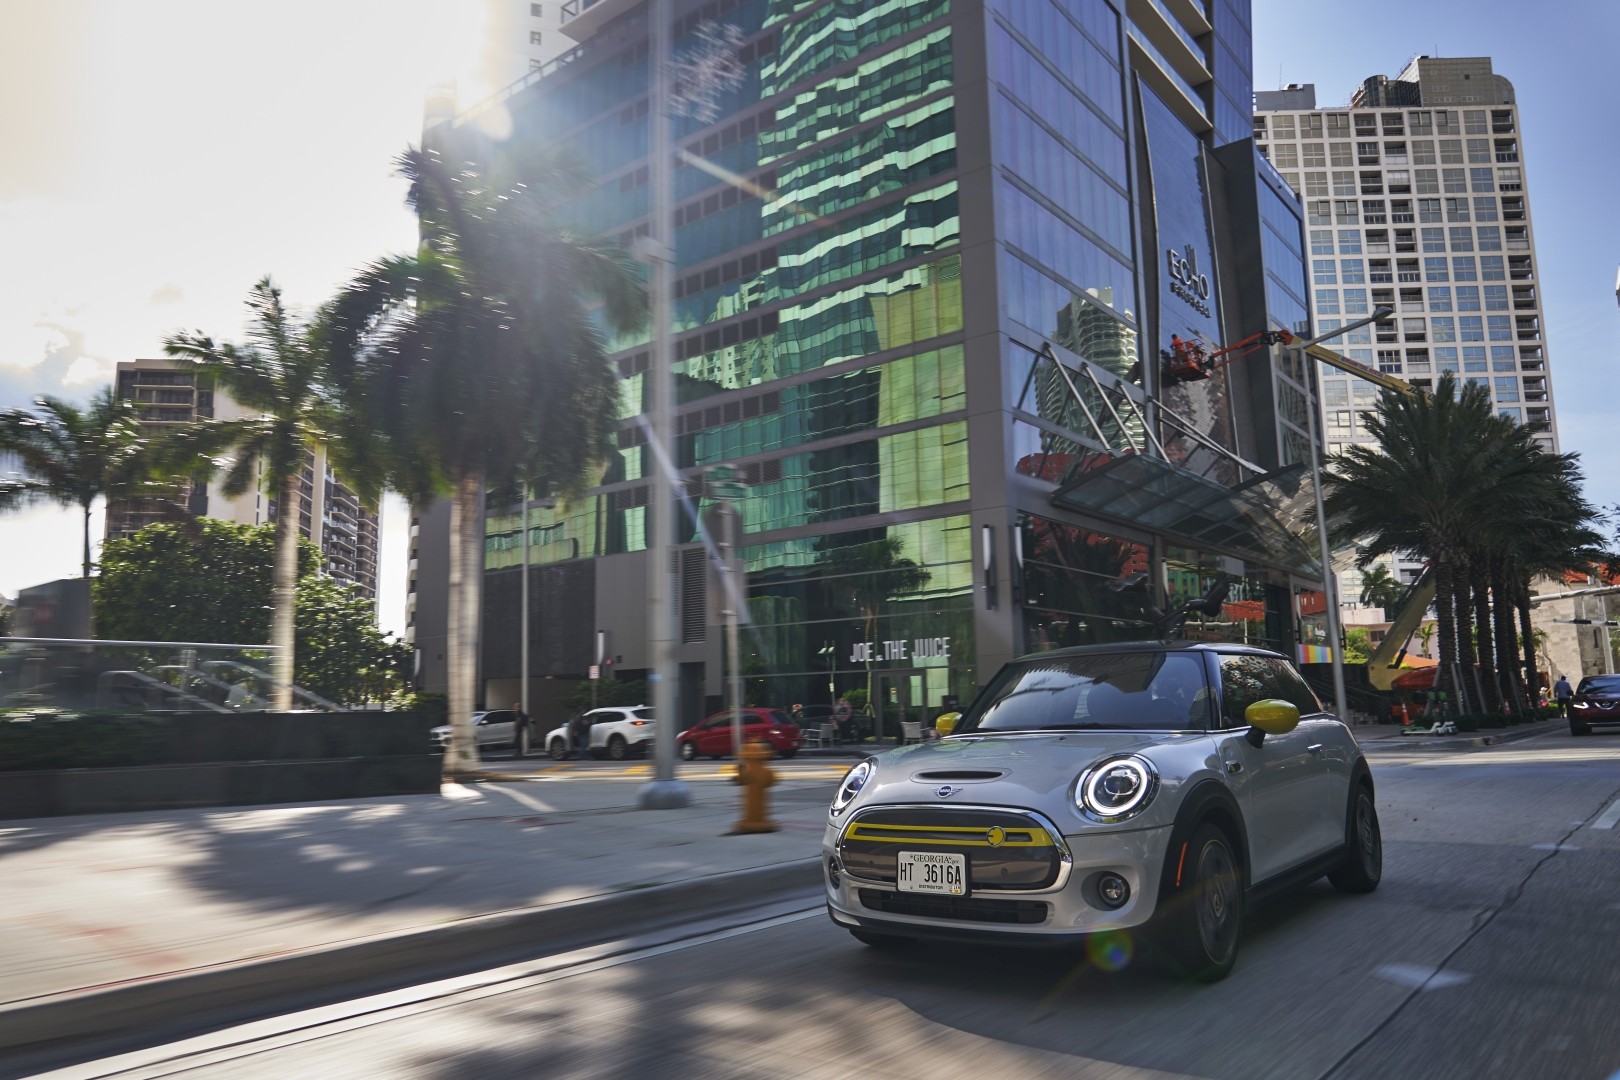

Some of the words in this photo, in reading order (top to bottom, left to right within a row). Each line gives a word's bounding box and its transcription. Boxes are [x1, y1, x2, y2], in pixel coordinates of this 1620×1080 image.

[850, 642, 874, 662] JOE
[882, 640, 908, 660] THE
[911, 637, 951, 658] JUICE
[900, 862, 914, 881] HT
[924, 863, 961, 885] 3616A
